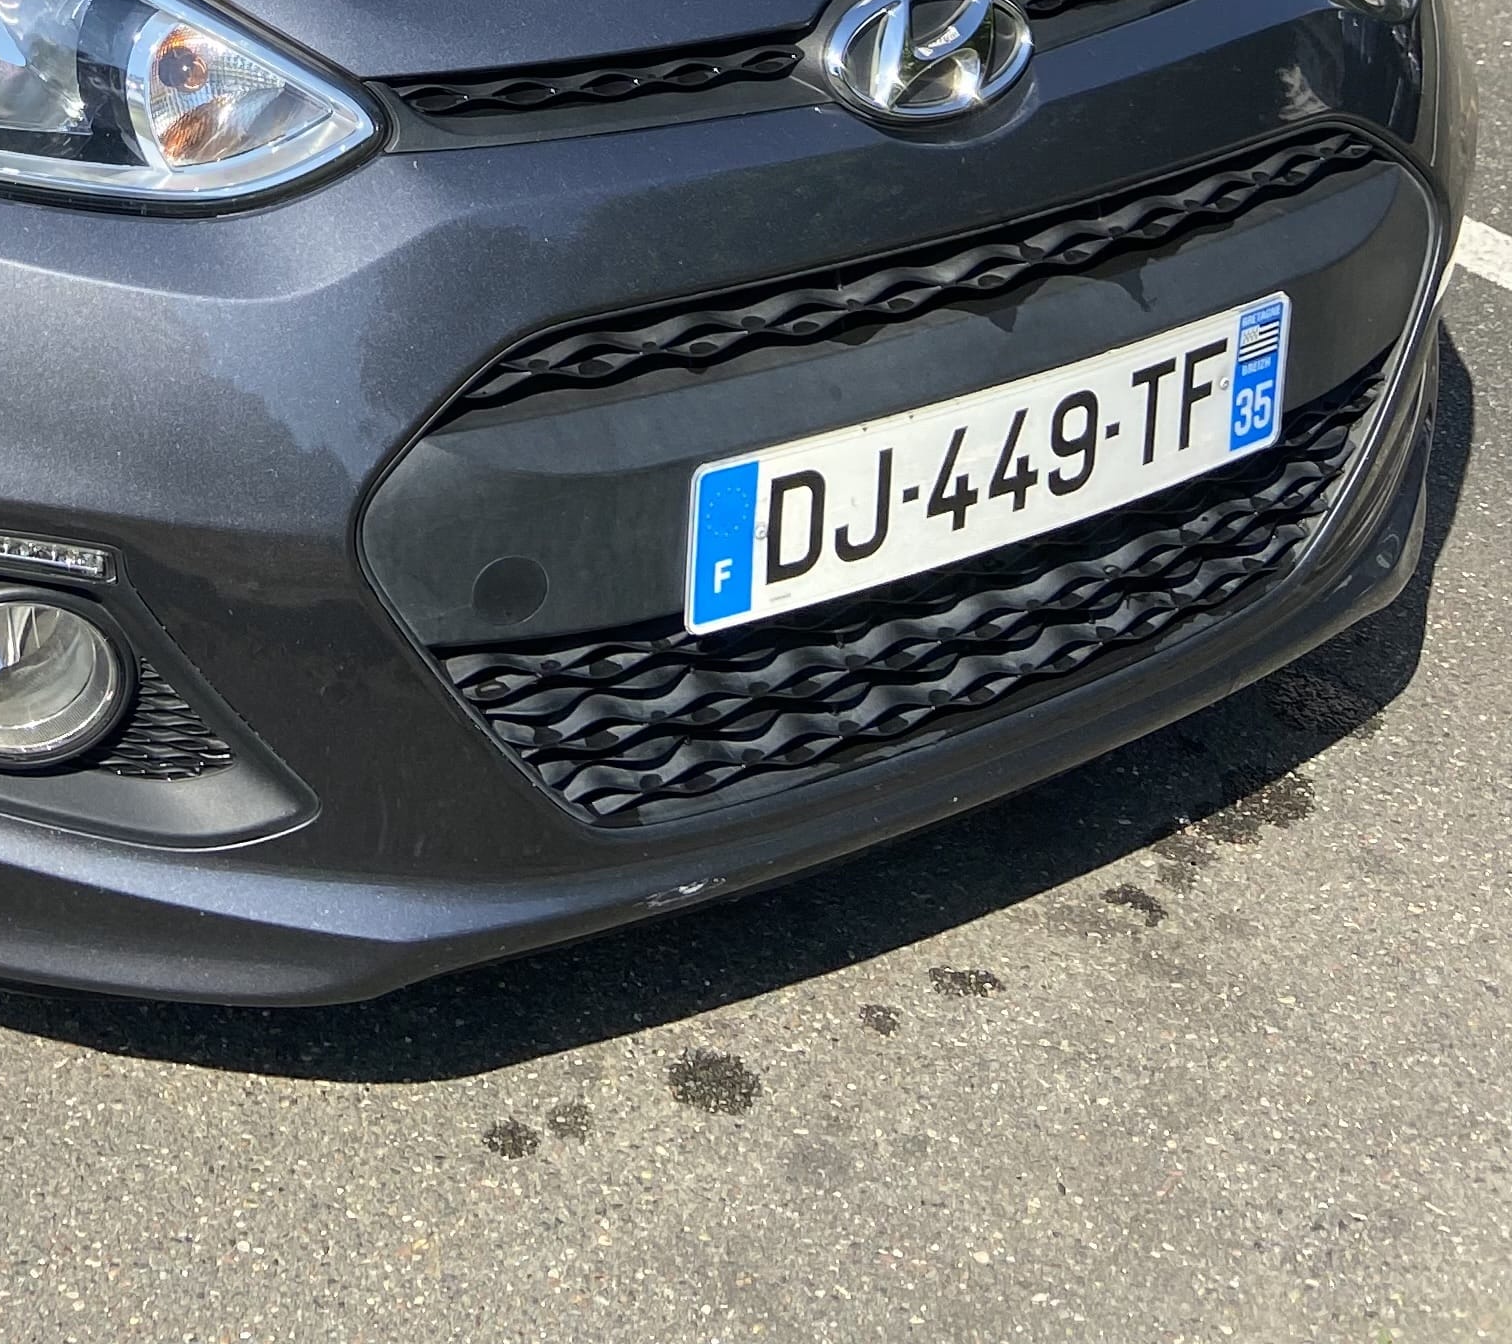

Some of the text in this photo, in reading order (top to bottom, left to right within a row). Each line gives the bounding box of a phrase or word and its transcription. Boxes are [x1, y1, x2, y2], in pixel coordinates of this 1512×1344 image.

[1234, 379, 1273, 437] 35
[765, 338, 1229, 587] DJ-449-TF
[713, 558, 732, 594] F
